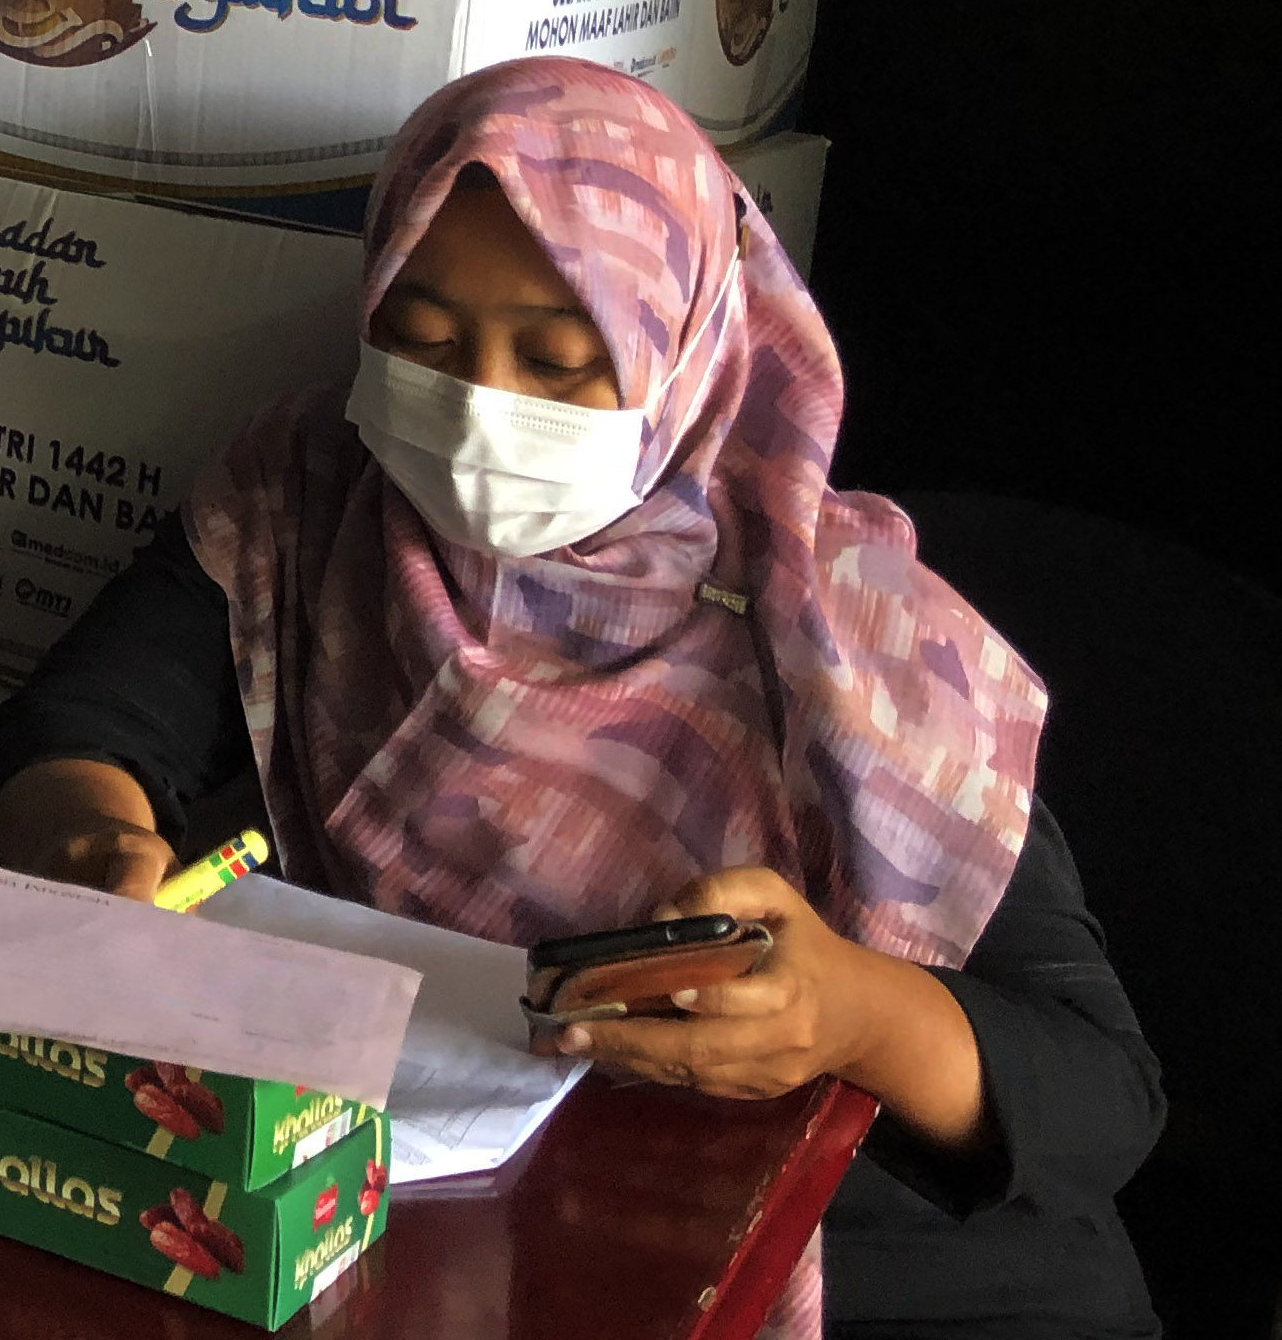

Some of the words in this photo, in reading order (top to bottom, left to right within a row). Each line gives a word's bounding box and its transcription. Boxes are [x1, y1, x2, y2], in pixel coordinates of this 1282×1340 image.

[48, 440, 127, 489] 1442
[139, 465, 162, 496] H
[28, 474, 104, 524] DAN
